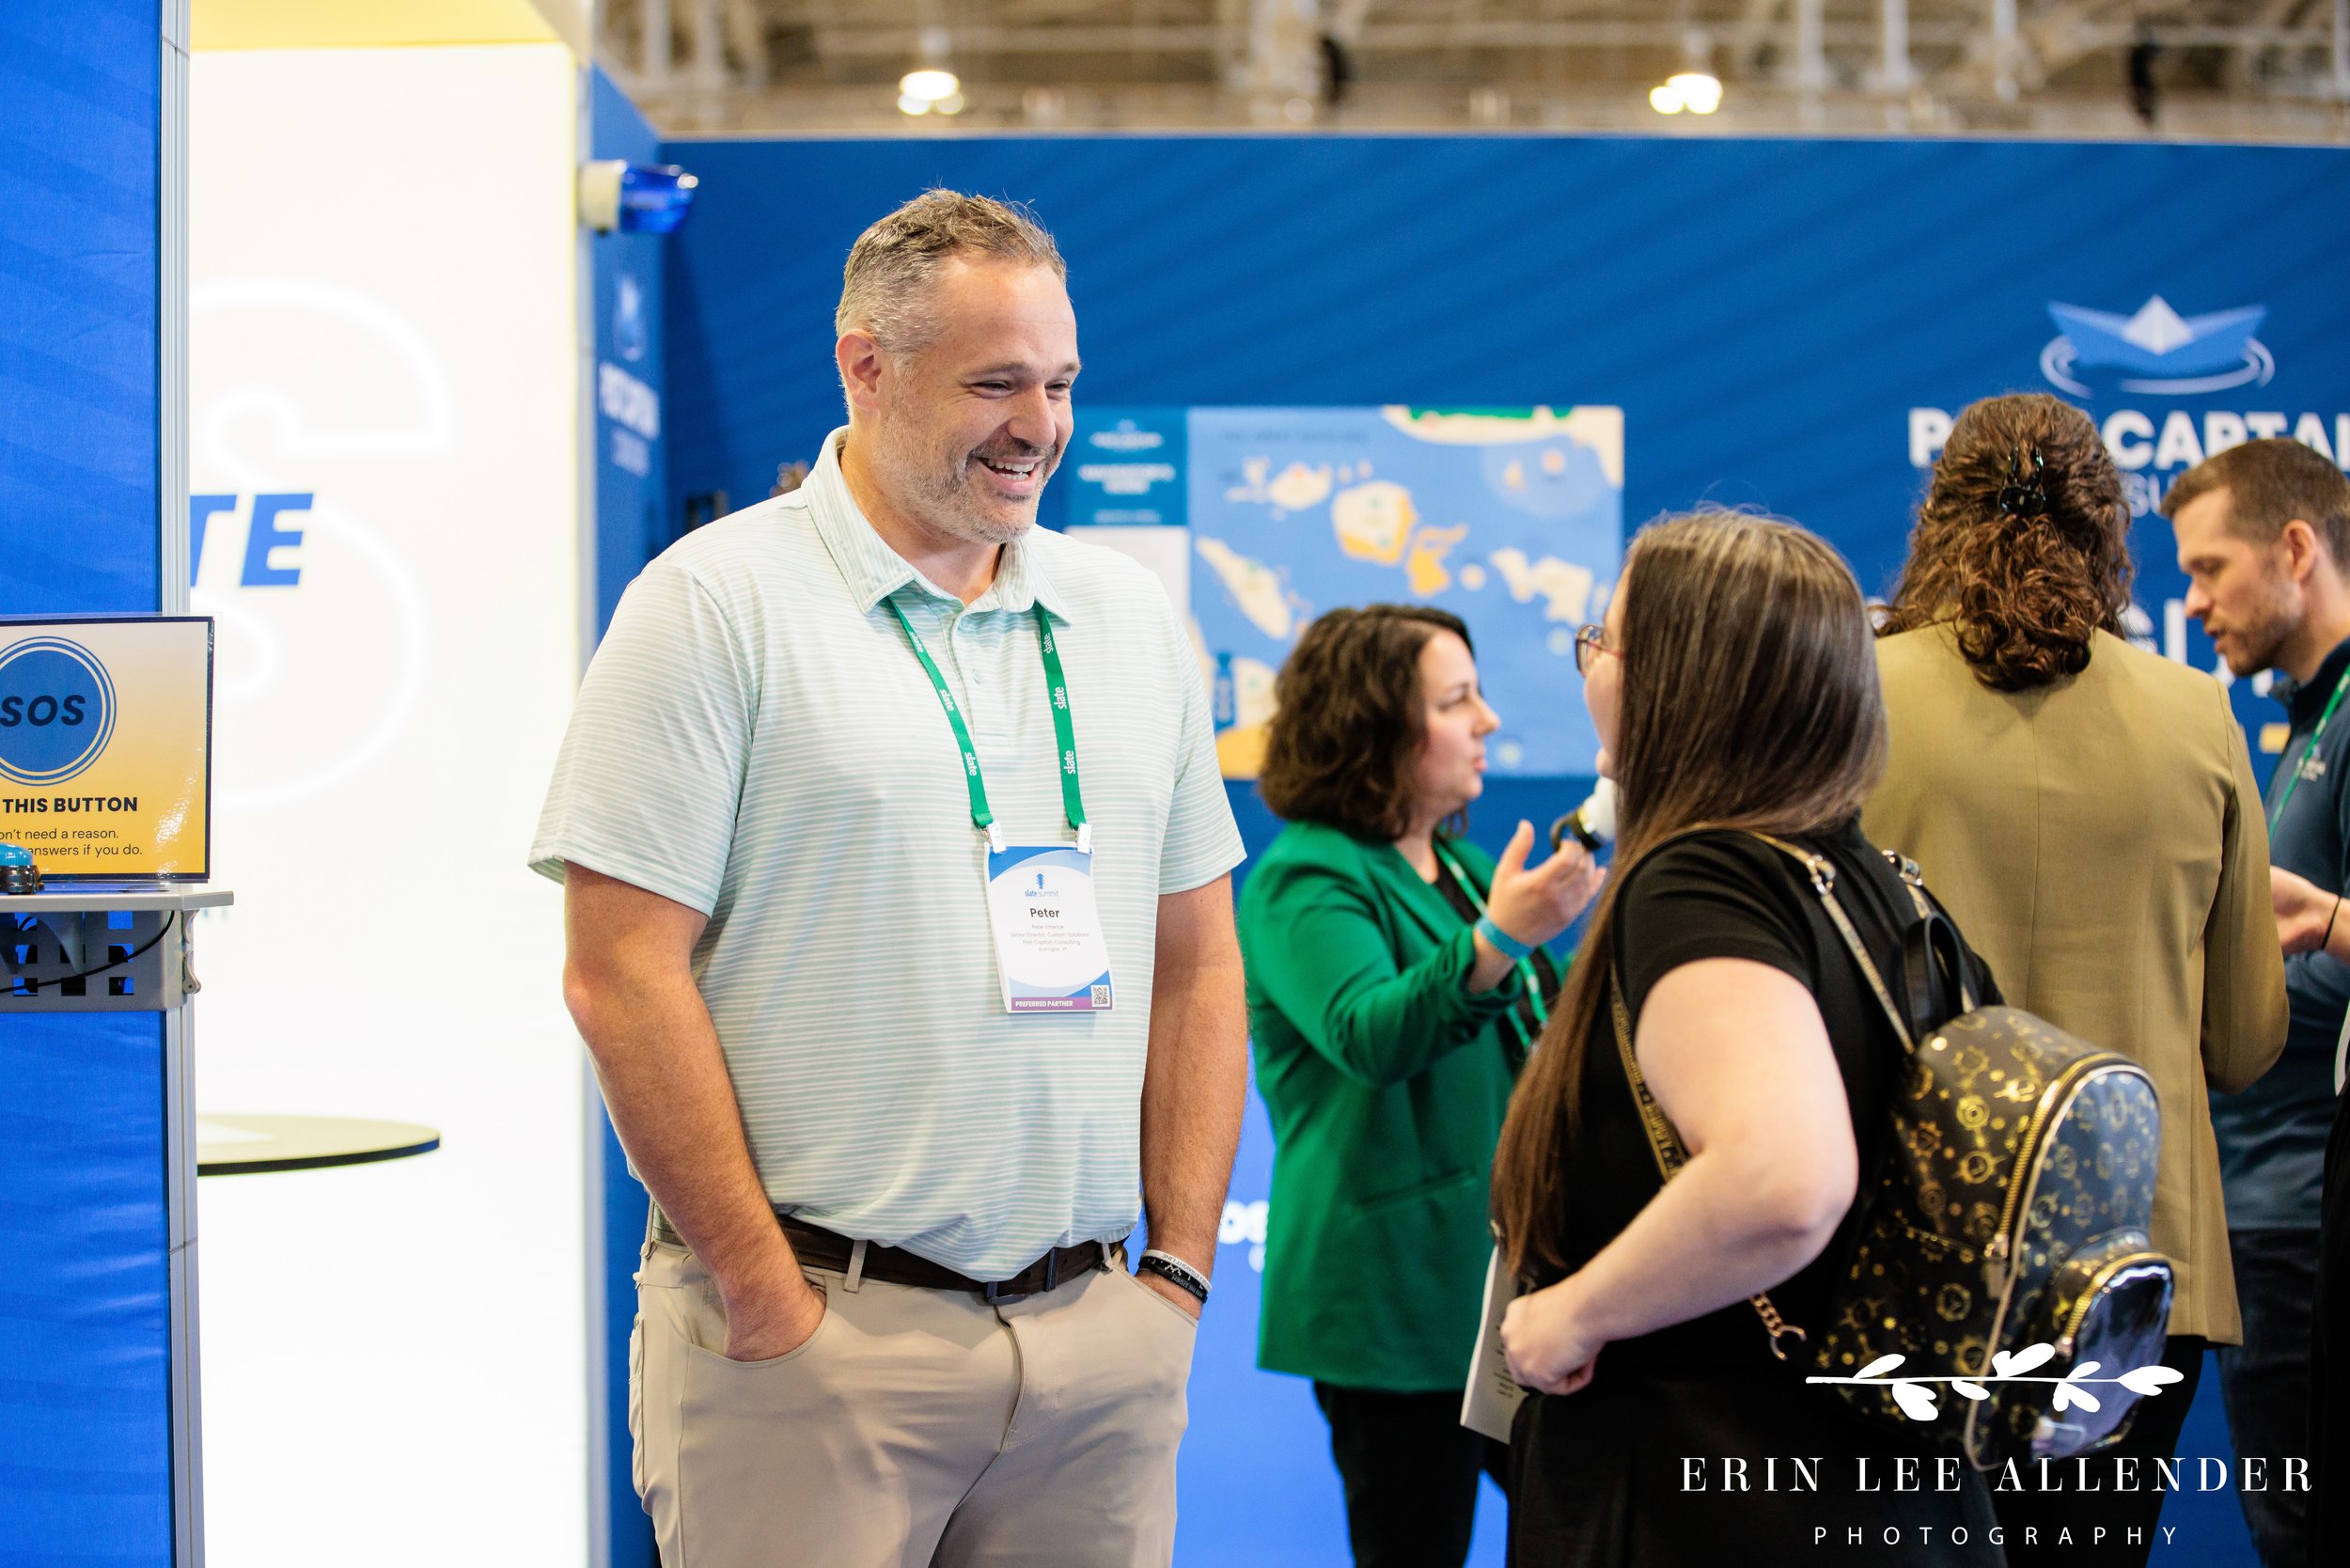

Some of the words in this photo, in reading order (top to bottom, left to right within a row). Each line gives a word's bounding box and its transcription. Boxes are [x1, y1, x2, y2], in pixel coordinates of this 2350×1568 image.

[909, 631, 924, 653] slate
[1043, 632, 1054, 654] slate
[940, 688, 954, 712] slate
[1054, 686, 1068, 710] slate
[0, 695, 86, 727] SOS
[964, 751, 977, 776] slate
[1063, 750, 1076, 775] slate
[3, 798, 48, 813] THIS
[54, 797, 138, 812] BUTTON
[25, 828, 57, 839] need
[72, 829, 118, 839] reason.
[83, 844, 91, 855] if
[95, 846, 118, 858] you
[123, 844, 143, 855] do.
[1030, 907, 1060, 917] Peter
[1171, 1276, 1188, 1288] STORM
